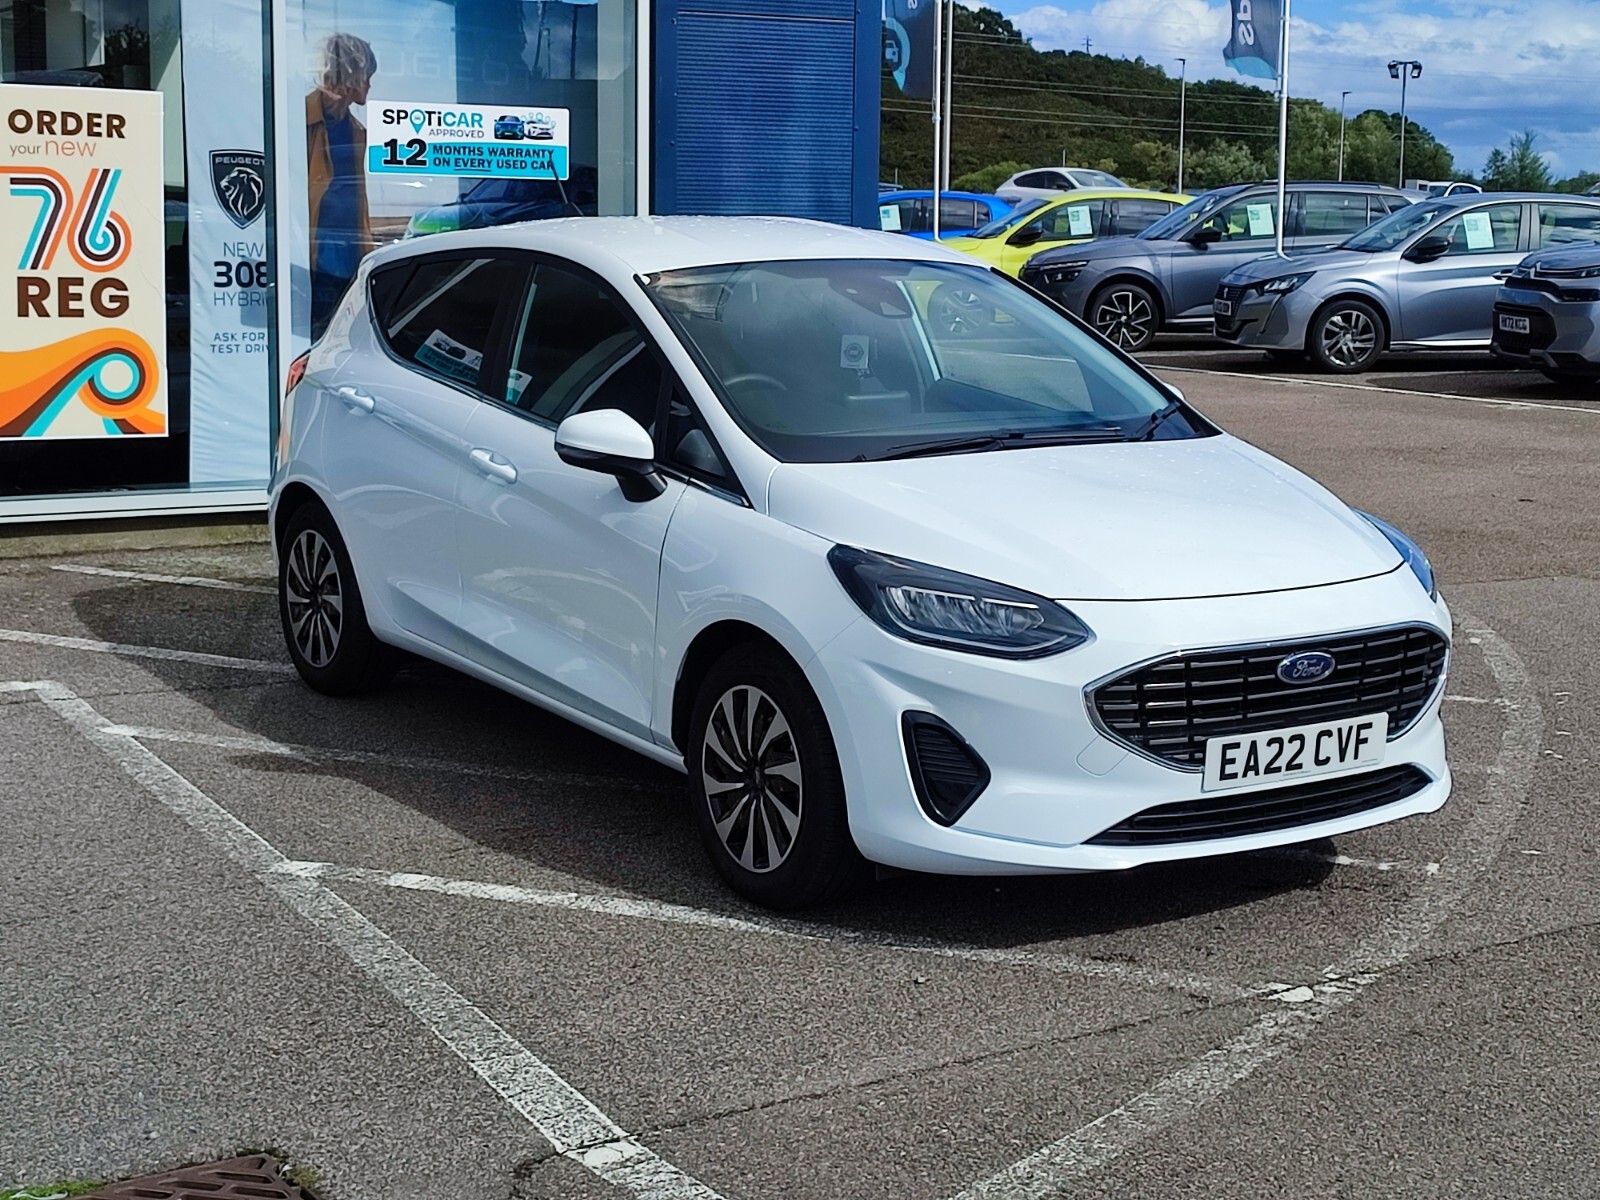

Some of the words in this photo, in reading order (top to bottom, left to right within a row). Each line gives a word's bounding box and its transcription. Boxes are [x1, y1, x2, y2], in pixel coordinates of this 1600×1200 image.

[7, 109, 127, 139] ORDER
[428, 128, 485, 139] APPROVED
[9, 143, 42, 157] your
[45, 139, 97, 157] new
[383, 138, 427, 166] 12
[432, 145, 484, 157] MONTHS
[488, 147, 554, 159] WARRANTY
[433, 157, 451, 167] ON
[454, 159, 492, 169] EVERY
[496, 159, 528, 170] USED
[0, 167, 132, 273] 76
[223, 242, 264, 258] NEW
[17, 276, 131, 319] REG
[213, 291, 267, 307] HYBRI
[213, 332, 238, 342] ASK
[242, 332, 266, 342] FOR
[210, 344, 241, 354] TEST
[245, 344, 268, 354] DRI
[1292, 658, 1325, 678] Ford
[1218, 733, 1306, 781] EA22
[1313, 722, 1374, 767] CVF
